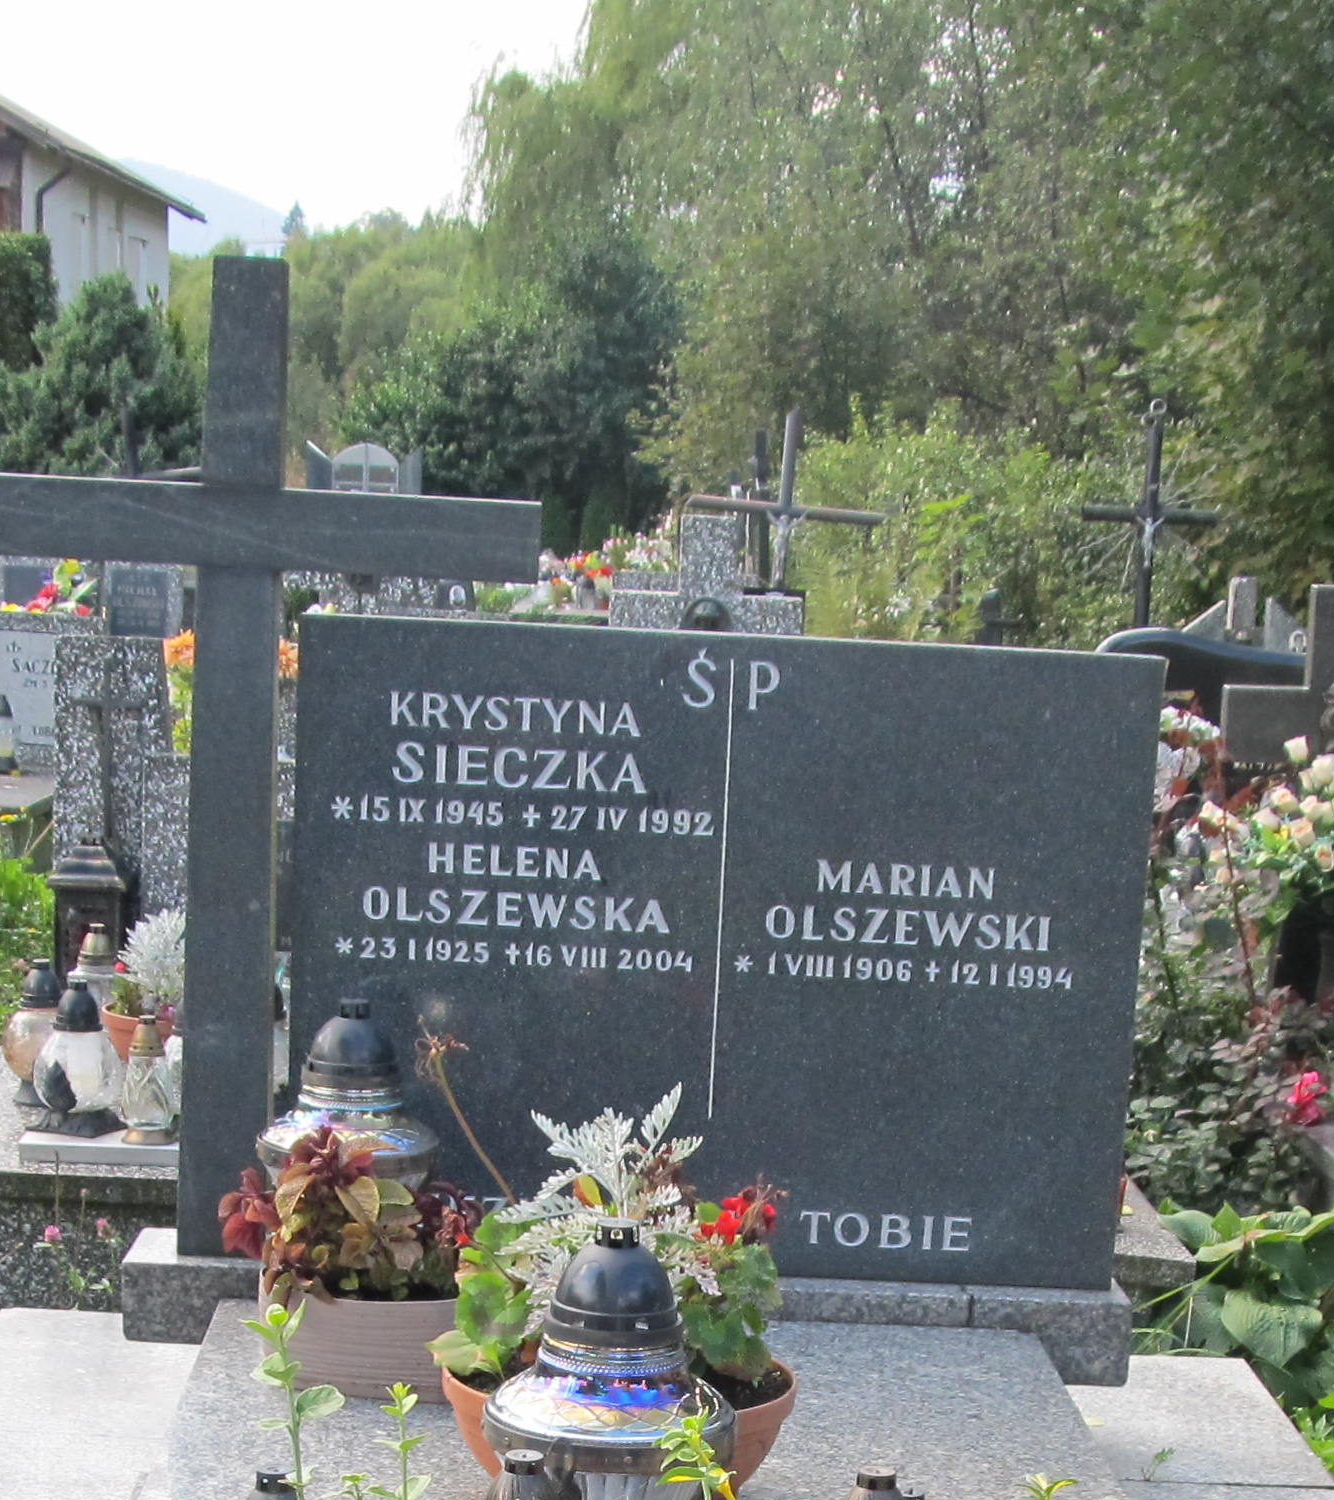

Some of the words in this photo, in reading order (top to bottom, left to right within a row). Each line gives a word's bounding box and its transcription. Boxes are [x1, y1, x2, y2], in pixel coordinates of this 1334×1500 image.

[390, 690, 642, 738] KRYSTYNA
[392, 740, 648, 795] SIECZKA
[399, 798, 427, 824] IX
[435, 799, 505, 828] 1945
[550, 804, 587, 832] 27
[597, 807, 629, 832] IV
[638, 808, 716, 837] 1992
[427, 841, 603, 882] HELENA
[816, 858, 997, 900] MARIAN
[362, 885, 671, 934] OLSZEWSKA
[765, 904, 1053, 952] OLSZEWSKI
[424, 937, 490, 964] 1925
[560, 944, 607, 969] VIII
[617, 949, 694, 974] 2004
[784, 954, 836, 978] VIII
[842, 953, 914, 983] 1906
[1005, 962, 1074, 990] 1994
[800, 1210, 975, 1252] TOBIE
